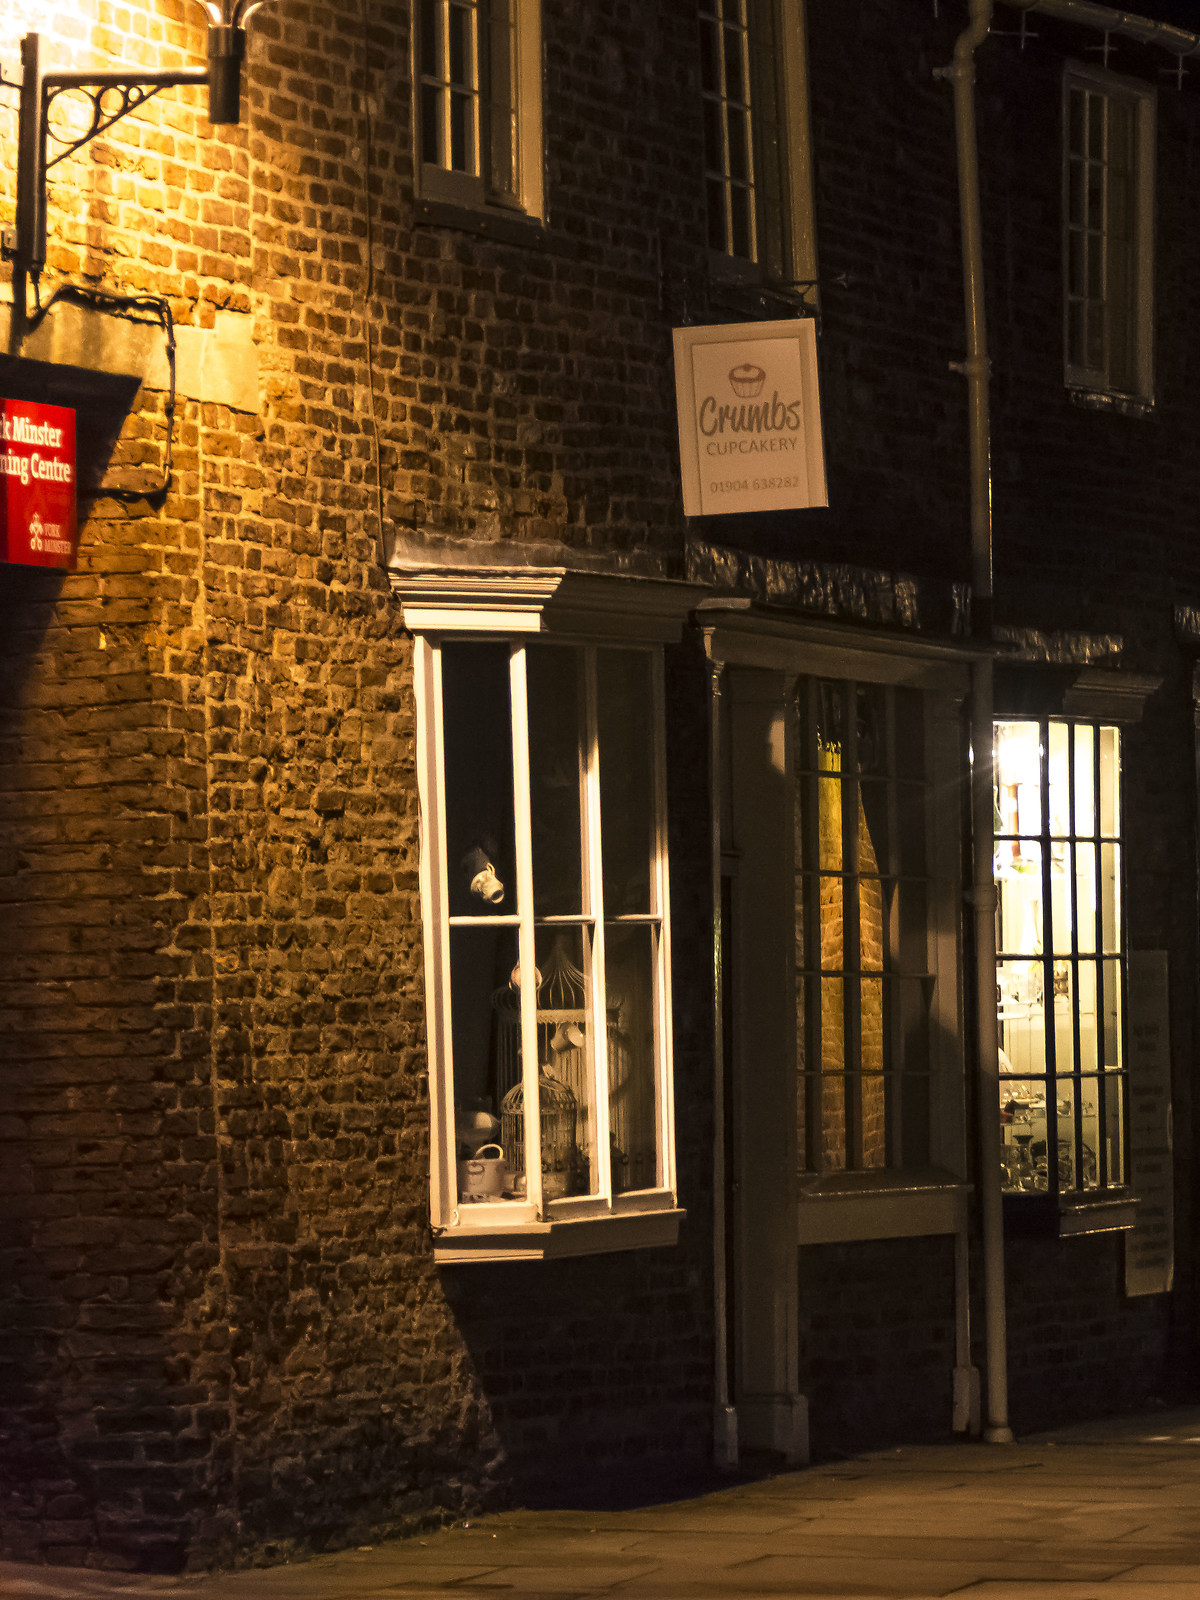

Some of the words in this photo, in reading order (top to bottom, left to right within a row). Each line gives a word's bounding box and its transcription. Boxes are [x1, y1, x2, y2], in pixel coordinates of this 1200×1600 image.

[699, 390, 801, 437] Crumbs
[12, 415, 62, 448] Minster
[706, 437, 798, 456] CUPCAKERY
[31, 452, 71, 483] Centre
[709, 479, 748, 494] 01904
